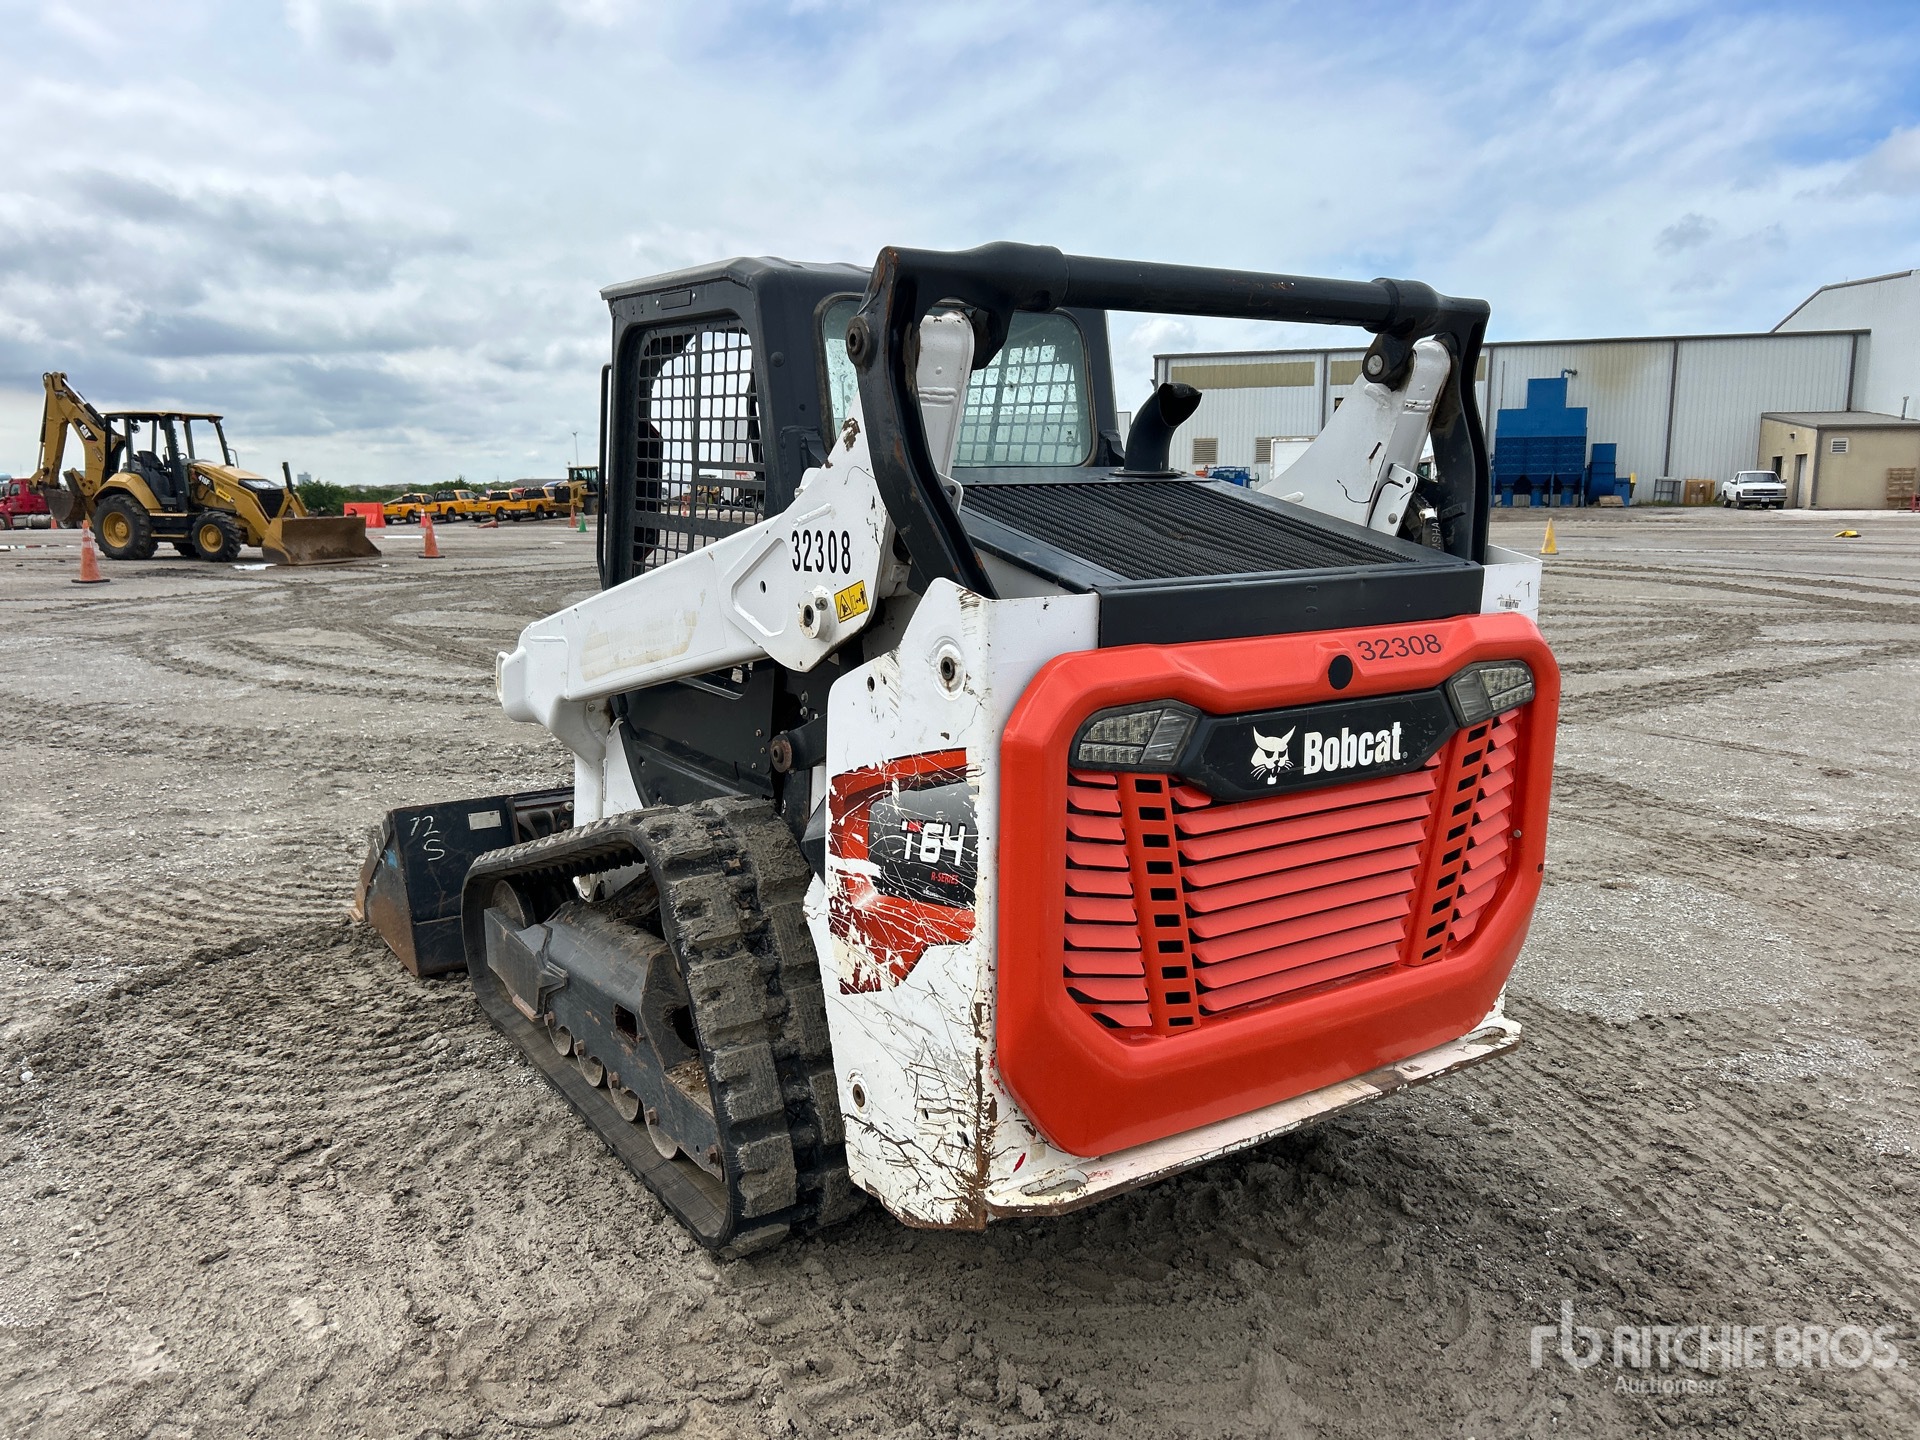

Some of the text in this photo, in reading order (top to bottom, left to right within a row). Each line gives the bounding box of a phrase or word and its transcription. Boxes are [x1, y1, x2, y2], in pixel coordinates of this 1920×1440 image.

[80, 424, 91, 439] CAT
[791, 529, 852, 575] 32308
[1357, 634, 1442, 661] 32308
[1303, 721, 1402, 776] Bobcat
[901, 819, 967, 867] T64
[930, 871, 960, 886] R-SERIES
